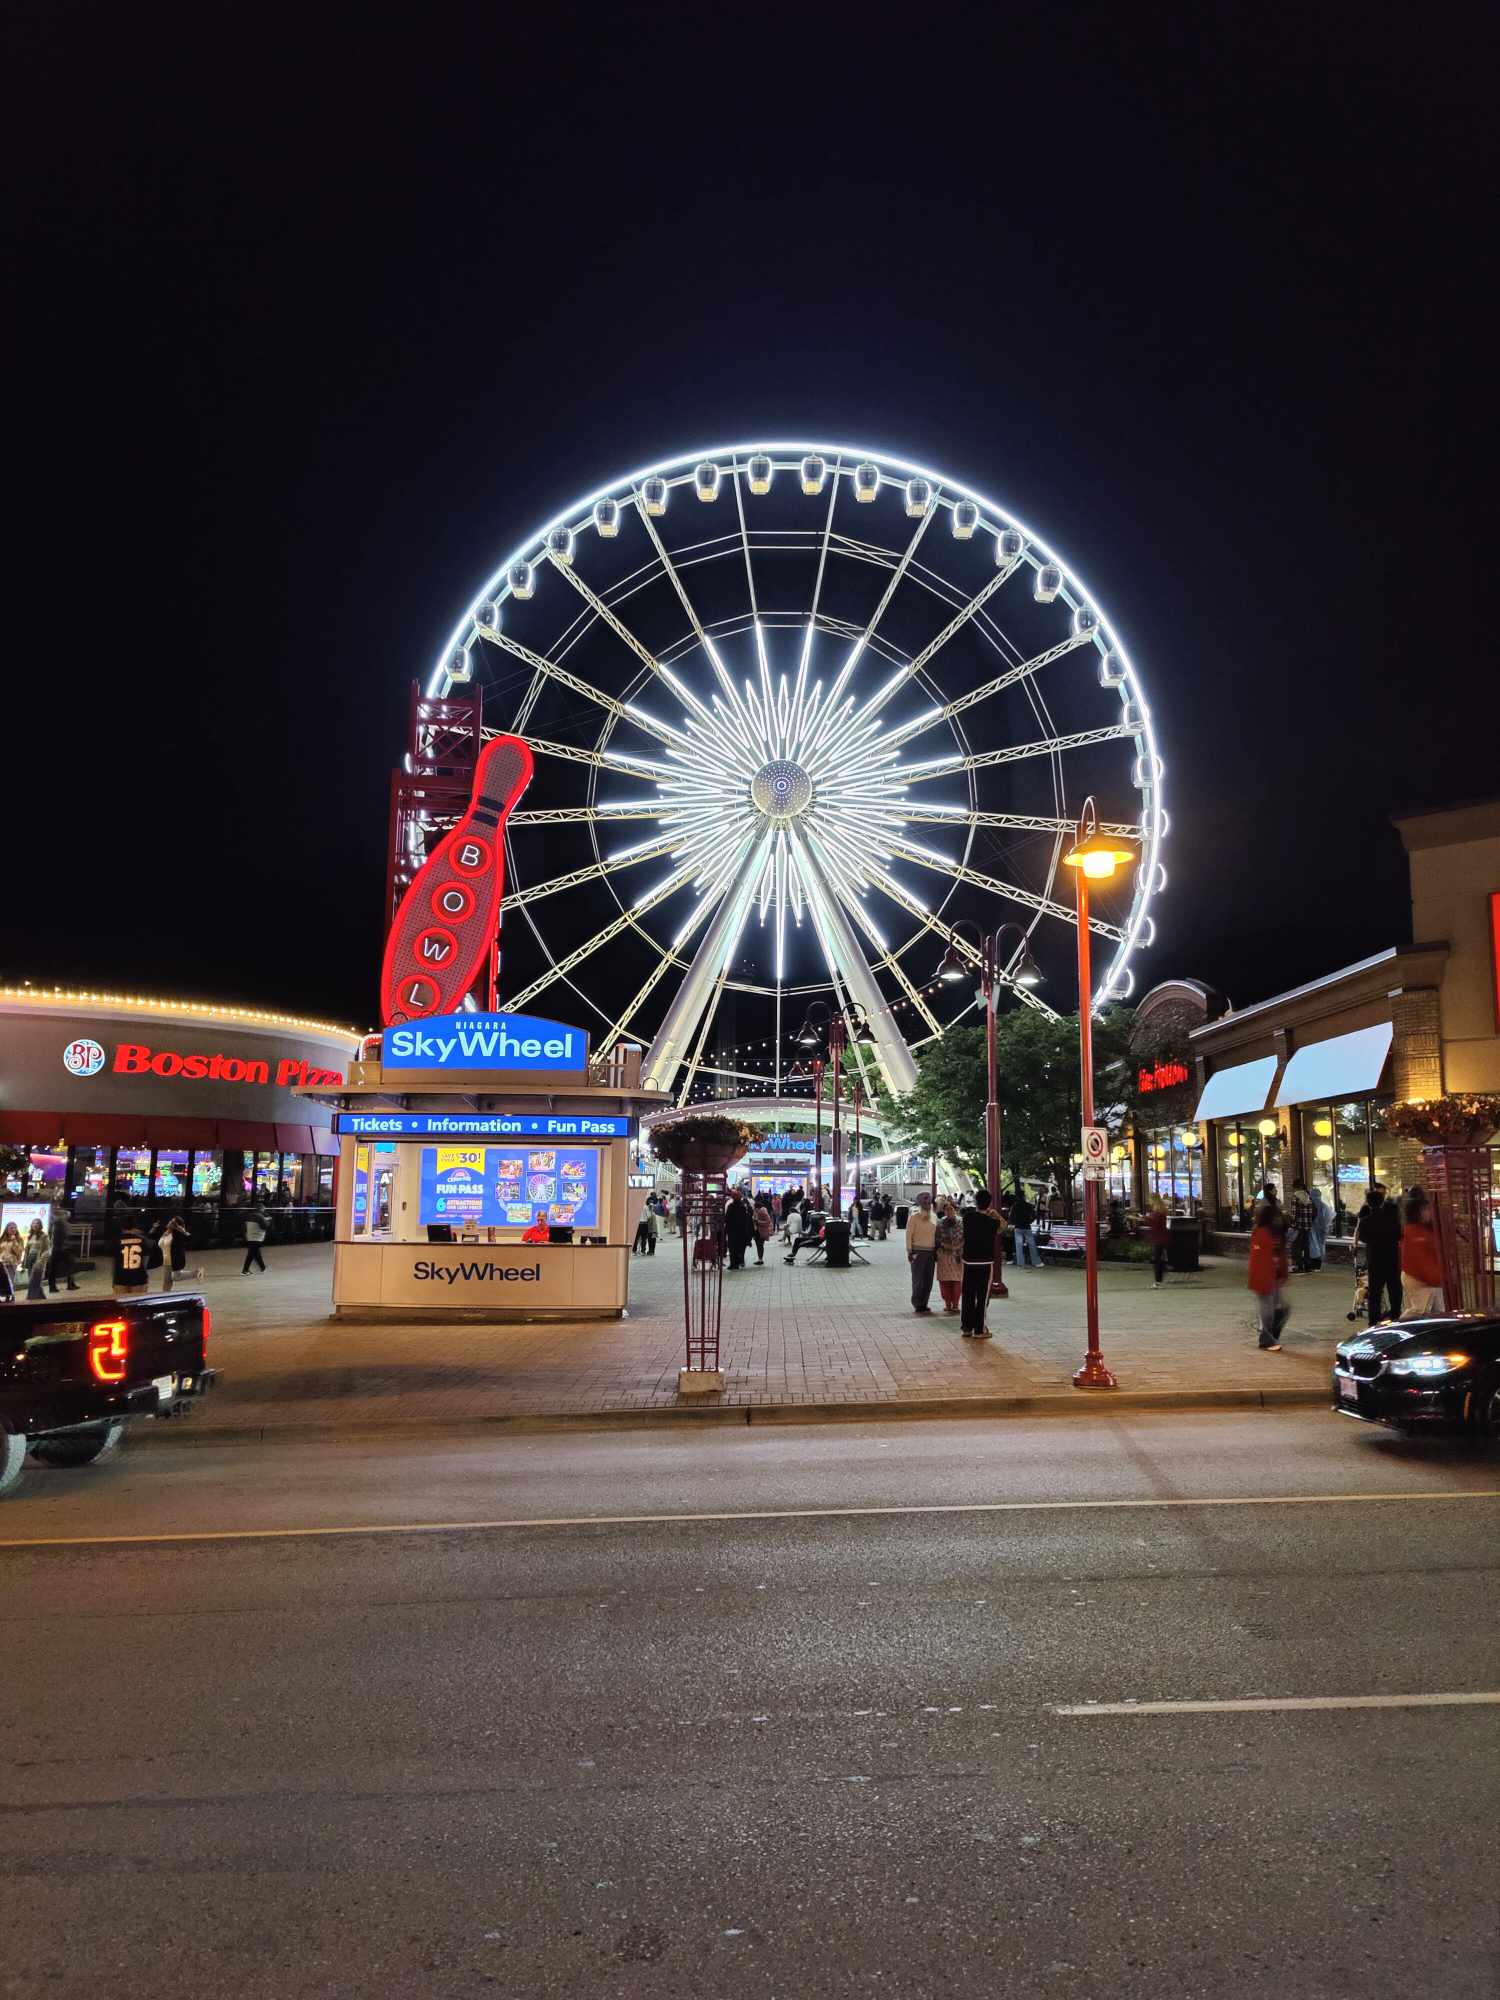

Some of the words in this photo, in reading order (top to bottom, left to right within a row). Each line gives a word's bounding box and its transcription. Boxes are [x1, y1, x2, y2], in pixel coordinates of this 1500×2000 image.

[409, 844, 480, 1007] BOWL
[455, 1021, 506, 1030] NIAGARA
[391, 1031, 572, 1062] SkyWheel
[113, 1044, 268, 1083] Boston
[276, 1060, 343, 1086] Pizza
[352, 1118, 402, 1131] Tickets
[427, 1119, 522, 1133] Information
[547, 1120, 577, 1133] Fun
[581, 1120, 616, 1134] Pass
[436, 1184, 456, 1194] FUN
[458, 1184, 484, 1194] PASS
[436, 1198, 446, 1211] 6
[121, 1245, 142, 1269] 16
[414, 1262, 541, 1283] SkyWheel
